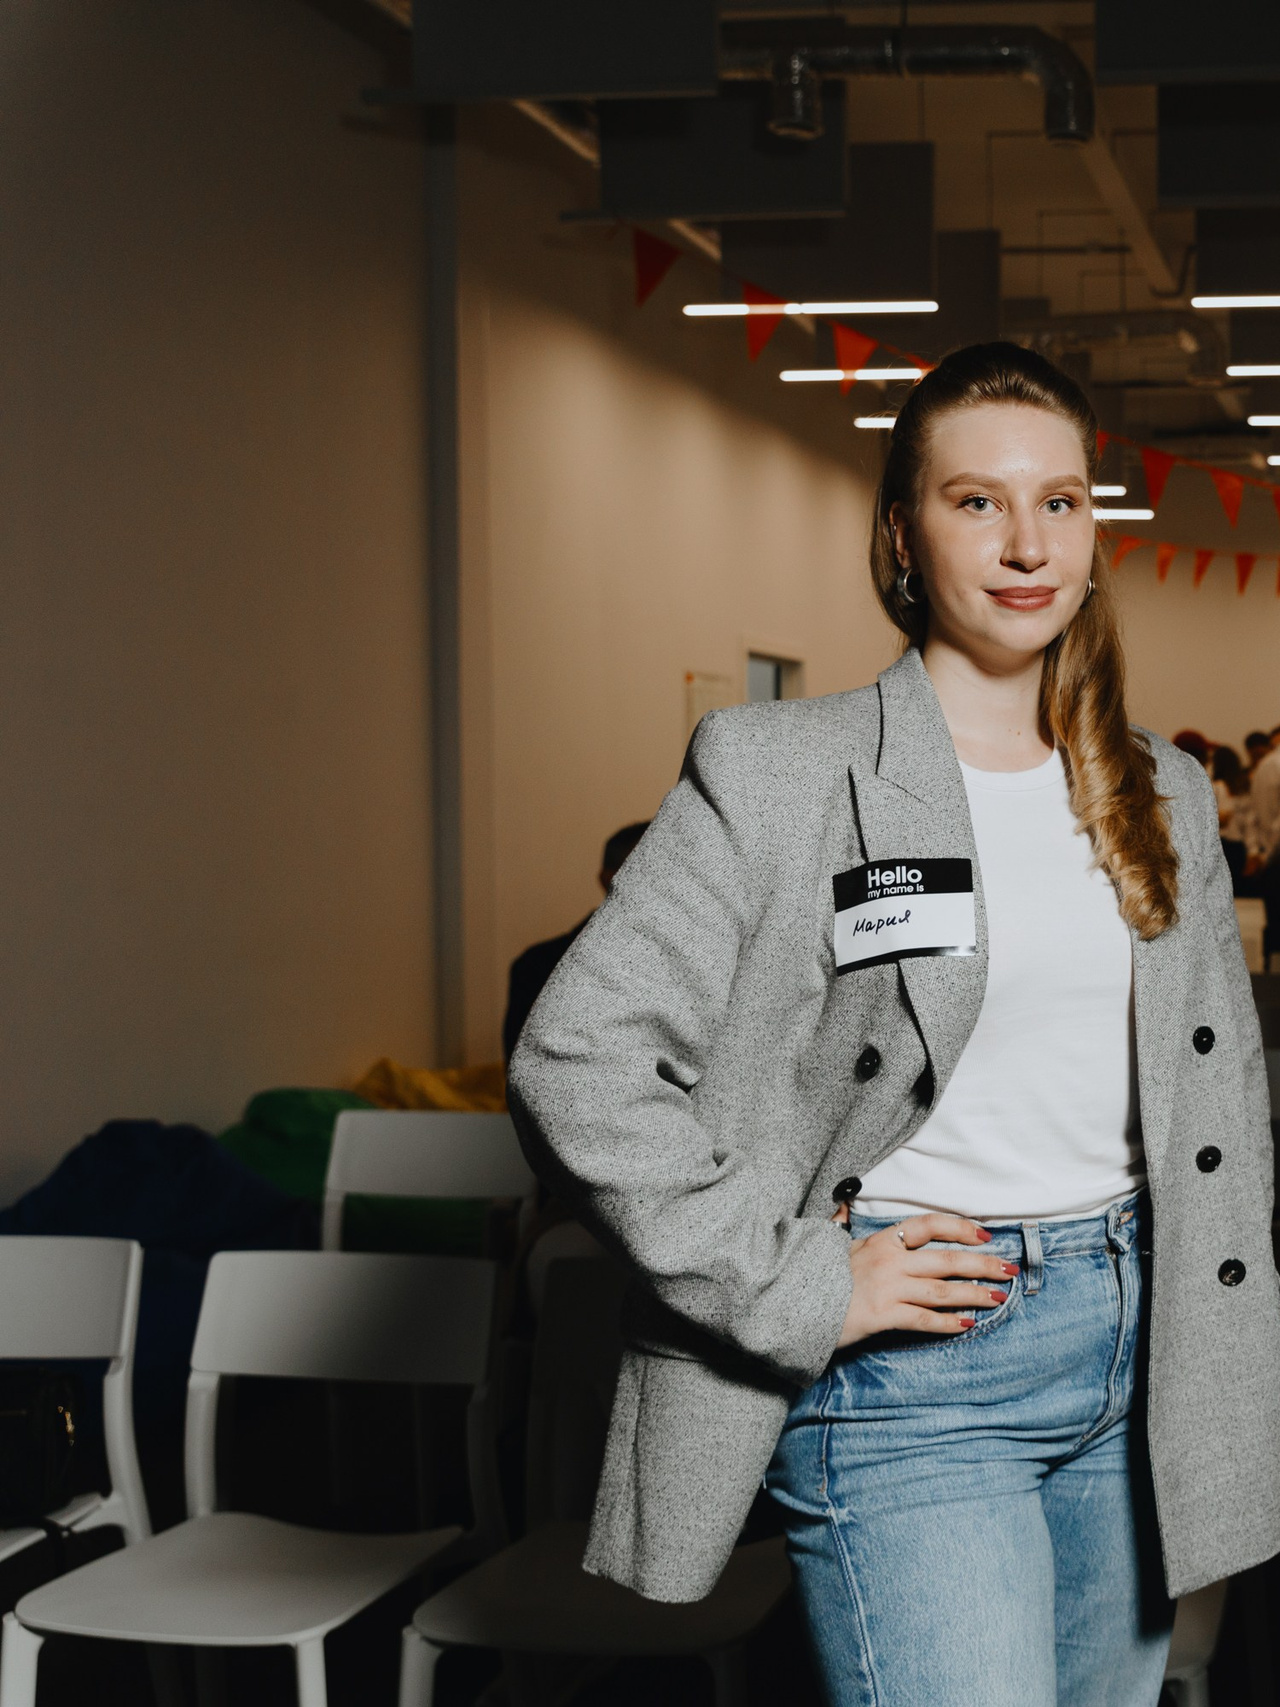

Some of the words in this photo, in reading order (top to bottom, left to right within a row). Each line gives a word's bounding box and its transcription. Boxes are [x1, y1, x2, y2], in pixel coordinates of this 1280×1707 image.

[867, 866, 923, 888] Hello
[867, 888, 881, 899] my
[883, 885, 914, 896] name
[916, 883, 925, 893] is
[852, 909, 912, 937] Мария
